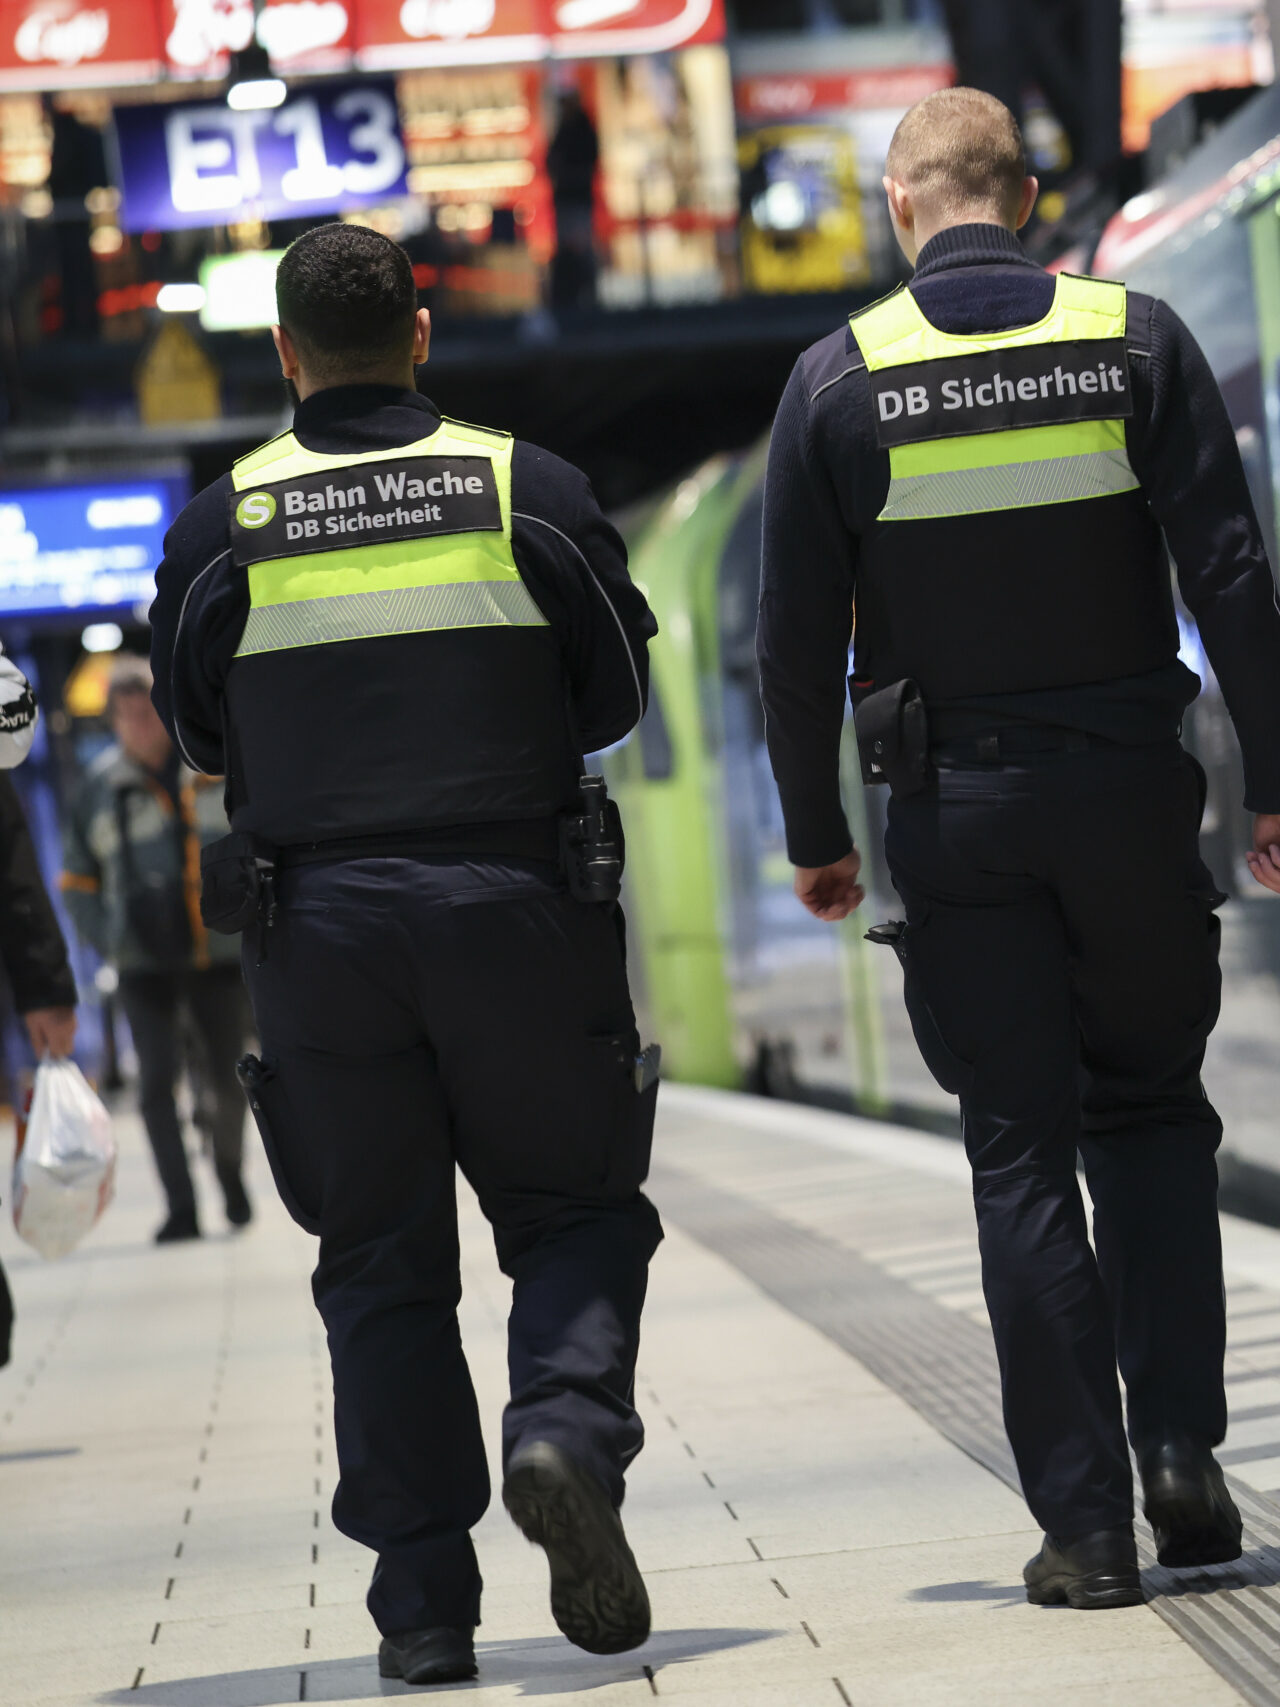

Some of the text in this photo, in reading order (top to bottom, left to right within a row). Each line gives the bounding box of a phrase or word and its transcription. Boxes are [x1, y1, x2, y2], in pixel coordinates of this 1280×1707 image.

[877, 362, 1125, 422] DB Sicherheit
[284, 471, 484, 516] Bahn Wache
[286, 504, 442, 540] DB Sicherheit
